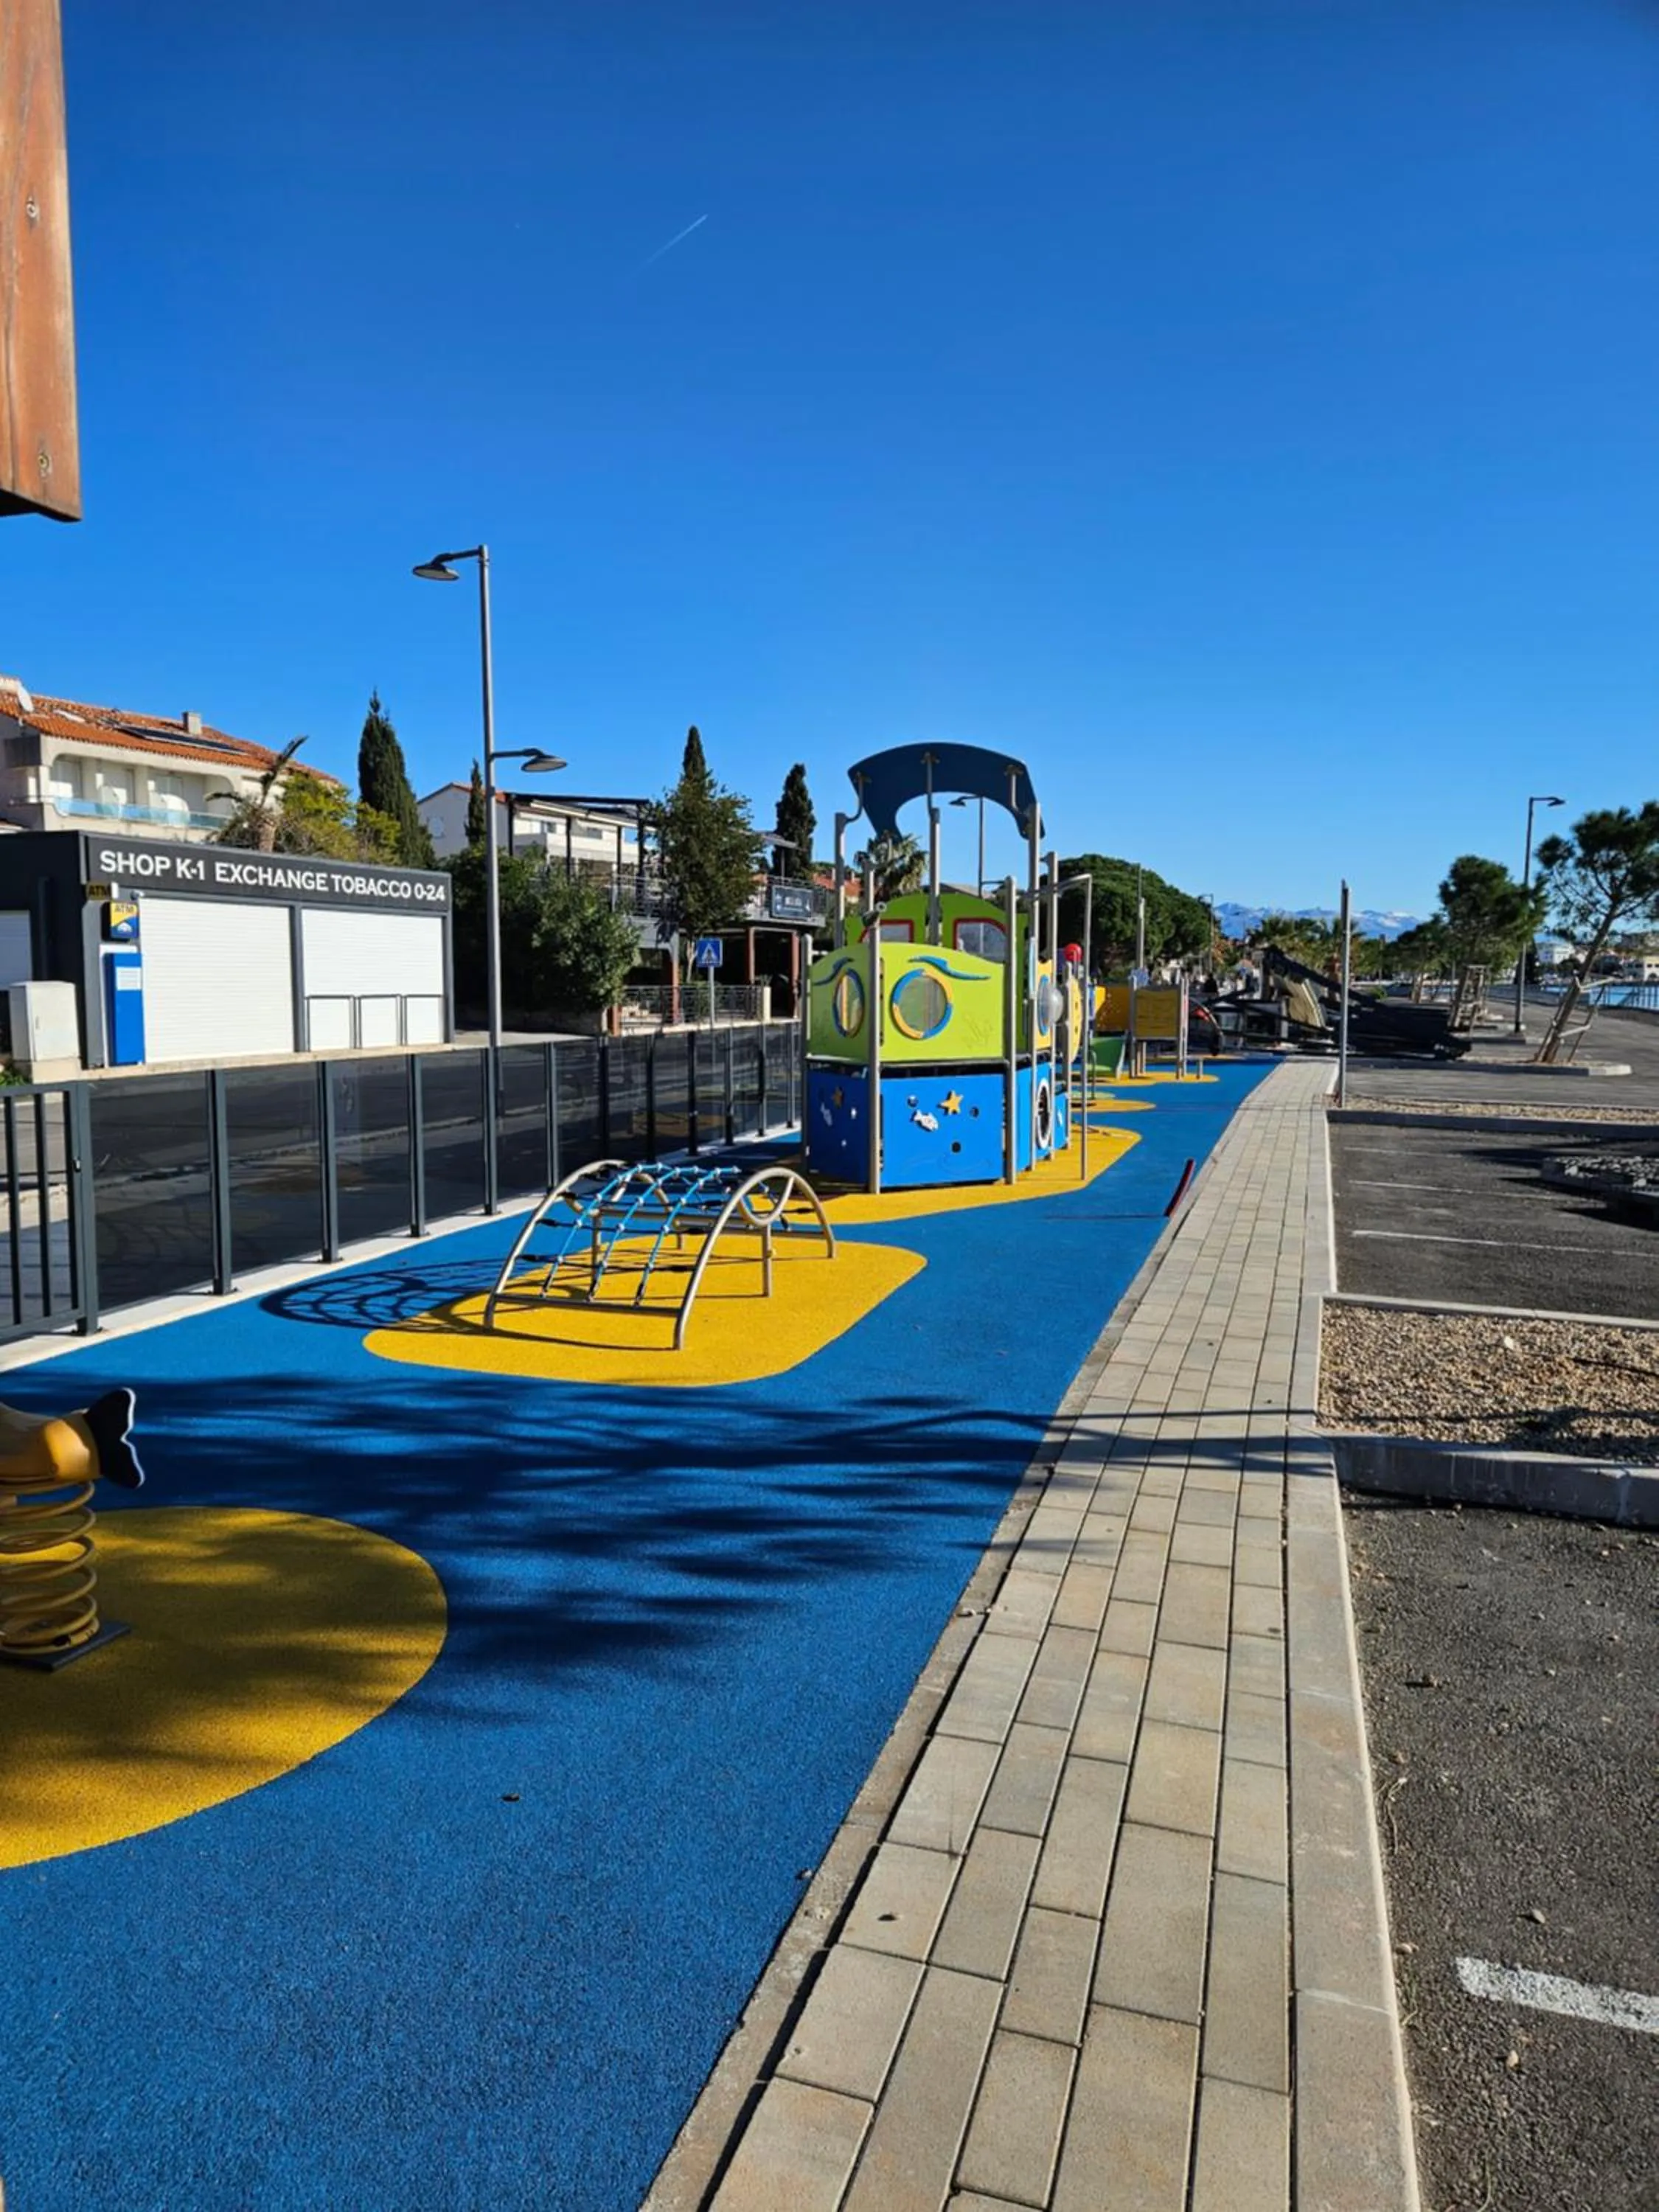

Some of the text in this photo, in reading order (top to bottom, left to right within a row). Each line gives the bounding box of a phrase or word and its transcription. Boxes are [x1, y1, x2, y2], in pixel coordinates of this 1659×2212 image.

[100, 850, 445, 901] SHOP K-1 EXCHANGE TOBACCO 0-24
[114, 902, 136, 913] ATM
